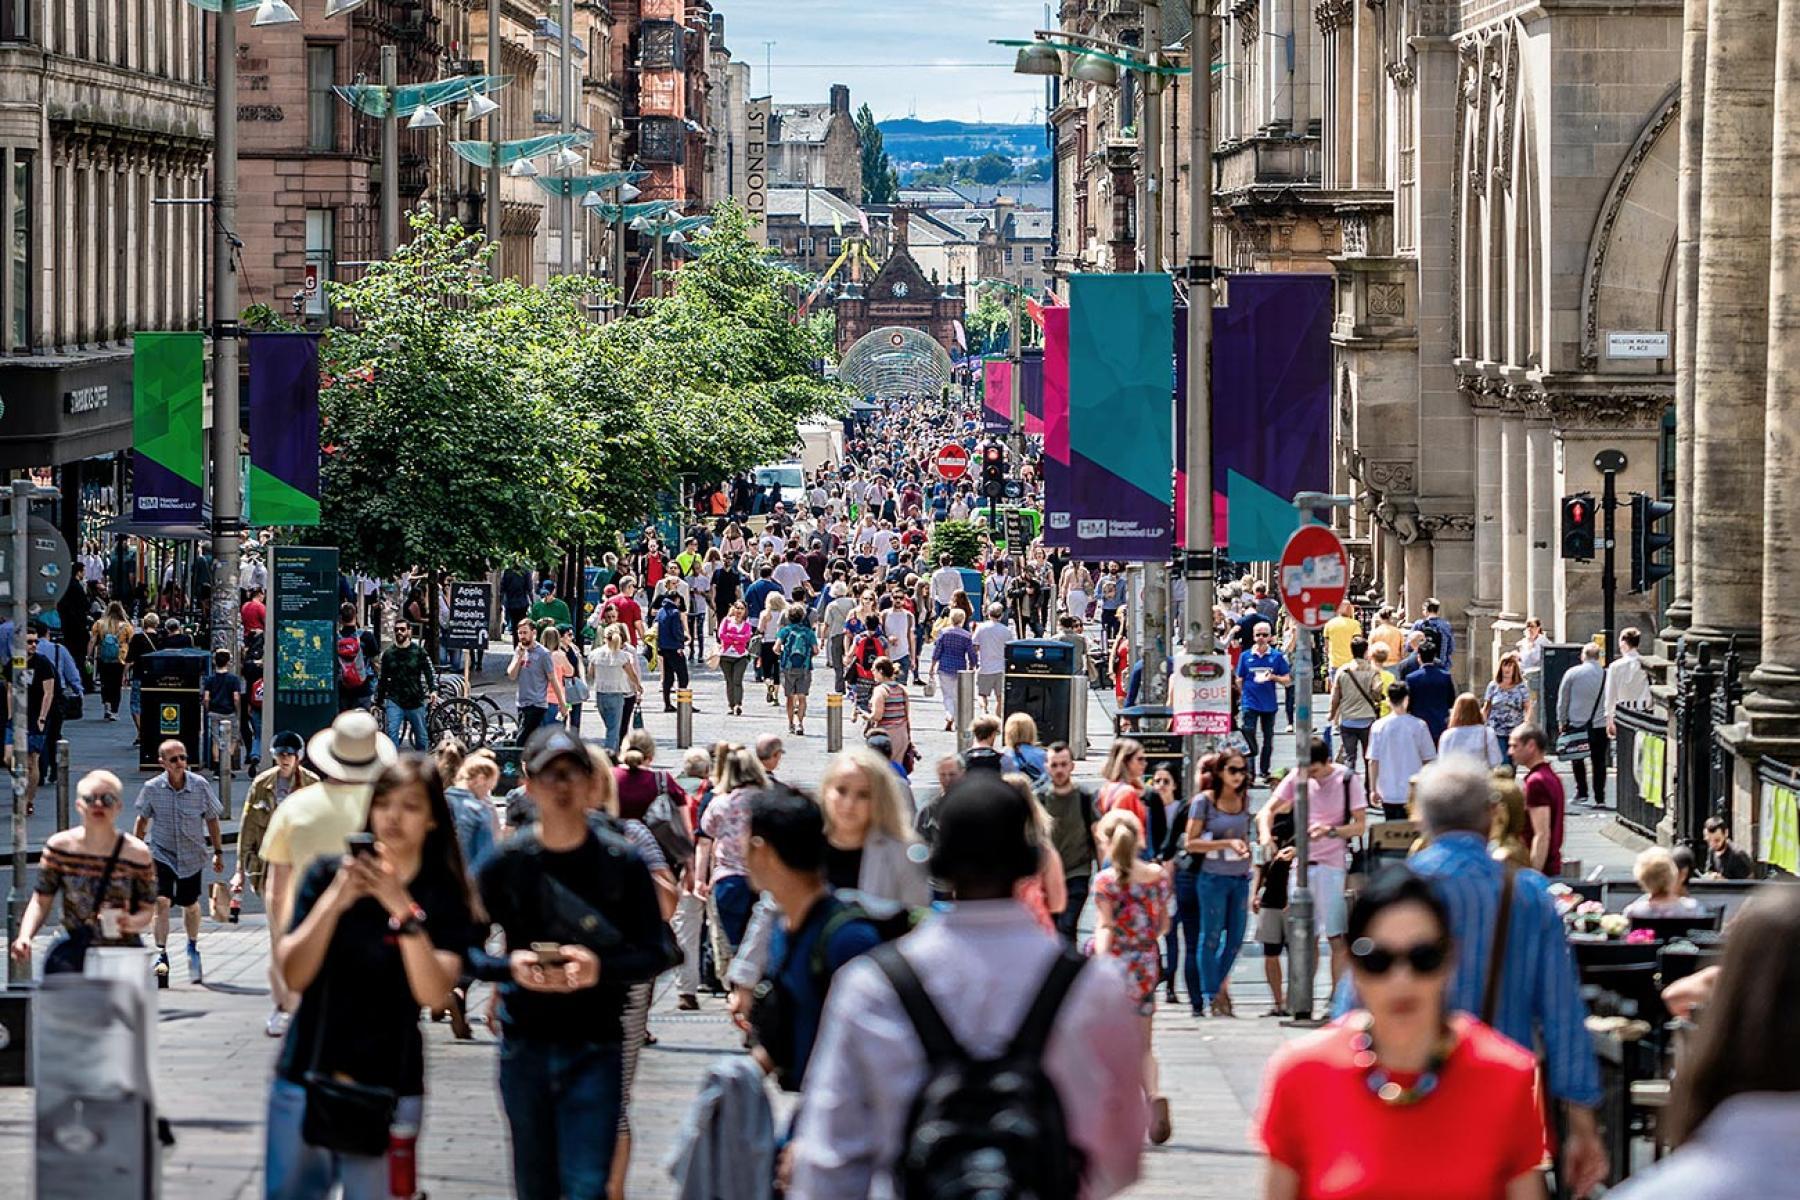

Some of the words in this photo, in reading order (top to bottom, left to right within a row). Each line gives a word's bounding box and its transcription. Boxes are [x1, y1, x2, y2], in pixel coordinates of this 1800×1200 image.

[748, 111, 764, 135] ST
[1078, 521, 1105, 536] HM
[1109, 520, 1138, 529] Harper
[1146, 528, 1164, 537] LLP
[458, 587, 483, 596] Apple
[454, 598, 476, 607] Sales
[478, 599, 486, 607] &
[454, 610, 485, 619] Repairs
